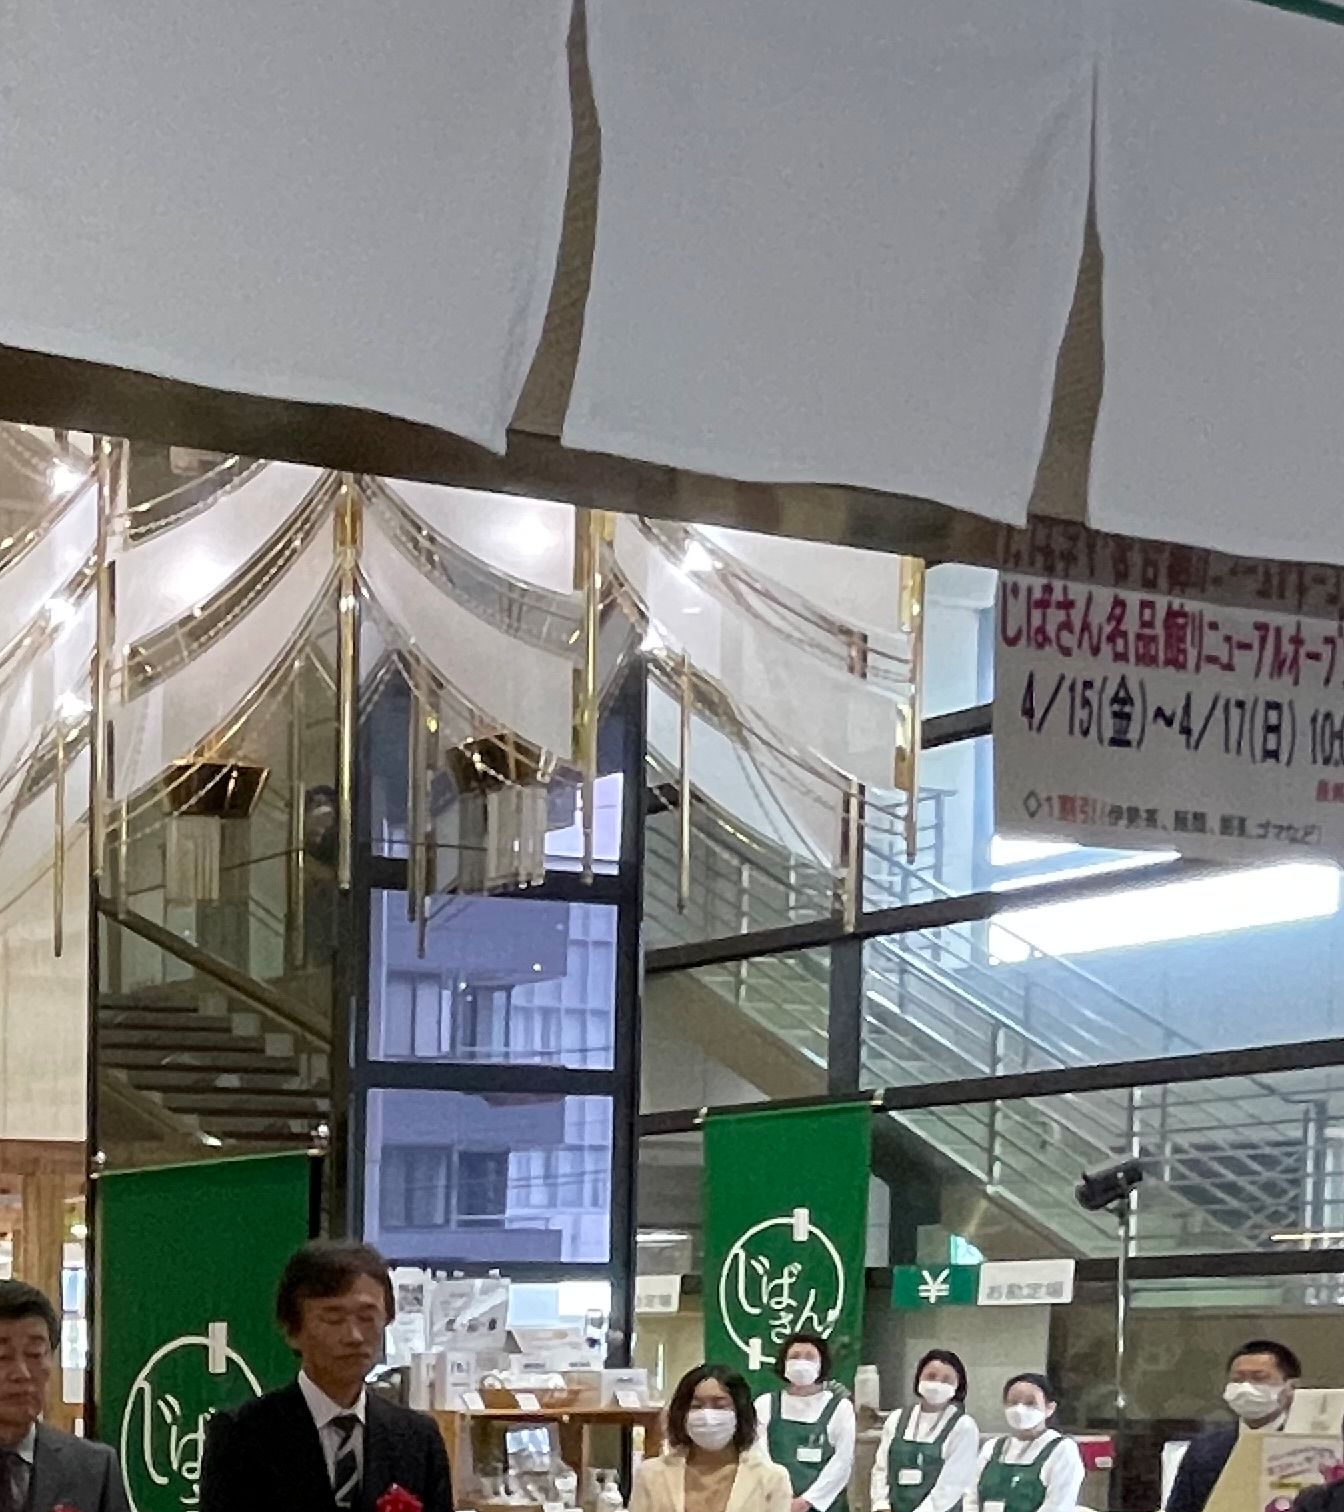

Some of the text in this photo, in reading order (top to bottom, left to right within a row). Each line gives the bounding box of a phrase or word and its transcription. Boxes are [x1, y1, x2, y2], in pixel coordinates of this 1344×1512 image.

[999, 580, 1344, 688] じばさん名品館リニューアルオープ
